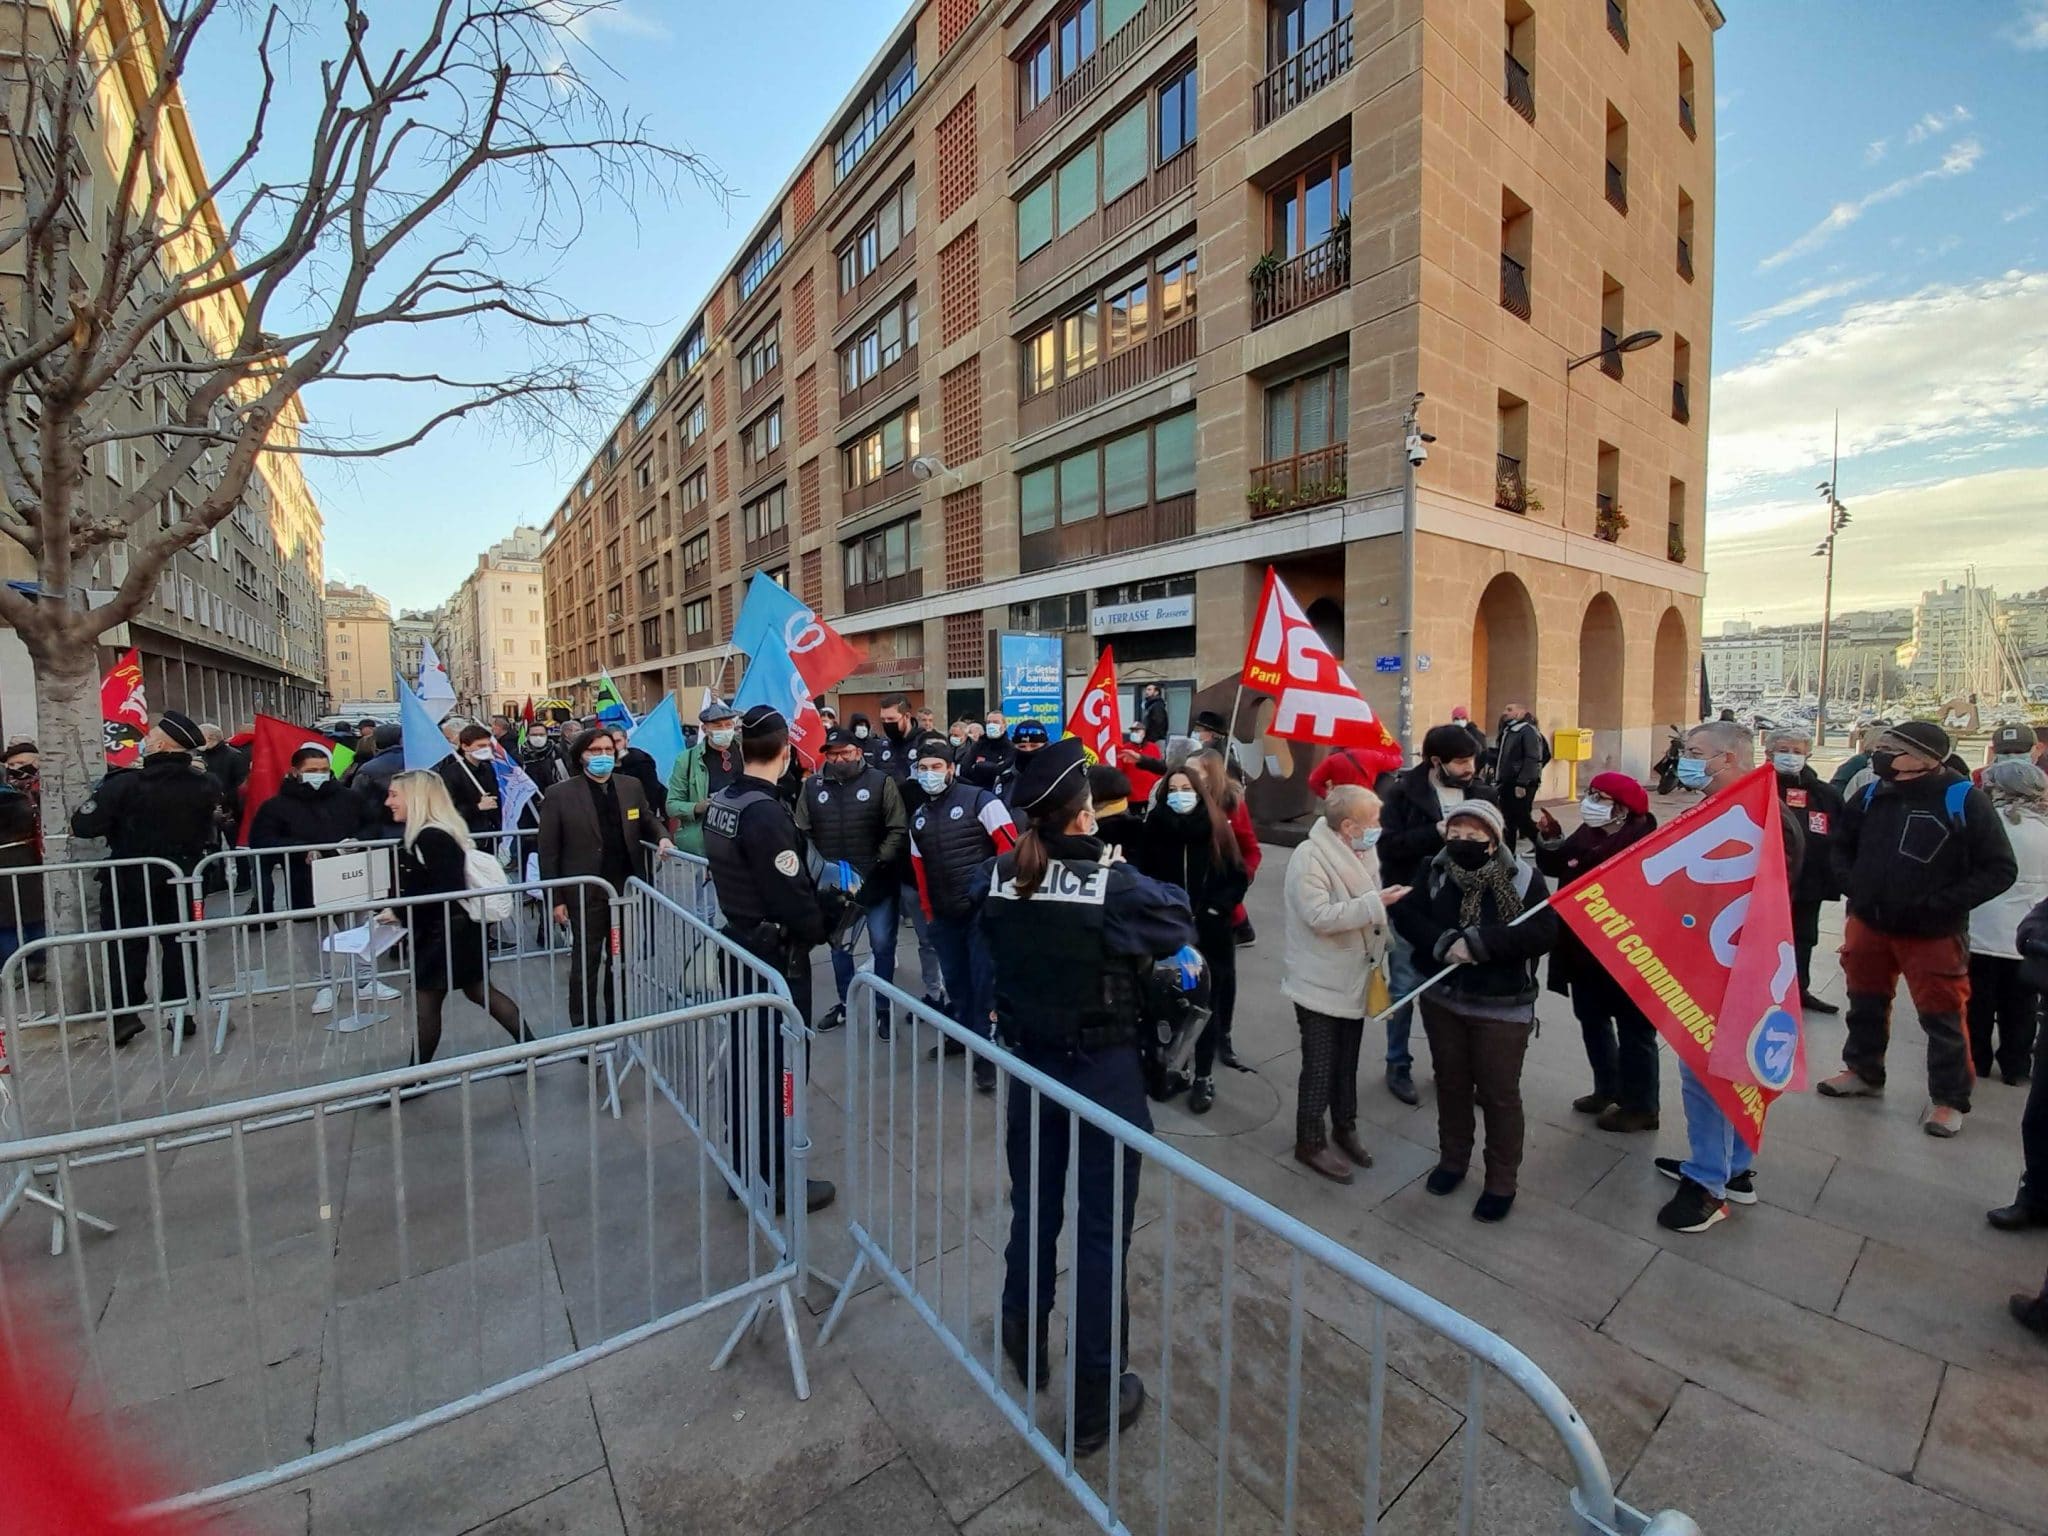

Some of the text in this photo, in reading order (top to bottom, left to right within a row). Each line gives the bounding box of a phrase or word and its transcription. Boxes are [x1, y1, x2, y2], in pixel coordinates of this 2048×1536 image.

[1094, 606, 1190, 627] LA TERRASSE Brasserie
[1250, 666, 1281, 686] Parti
[1017, 683, 1060, 693] vaccination
[1032, 703, 1059, 713] notre
[341, 868, 364, 881] ELUS
[1574, 883, 1635, 939] Parti
